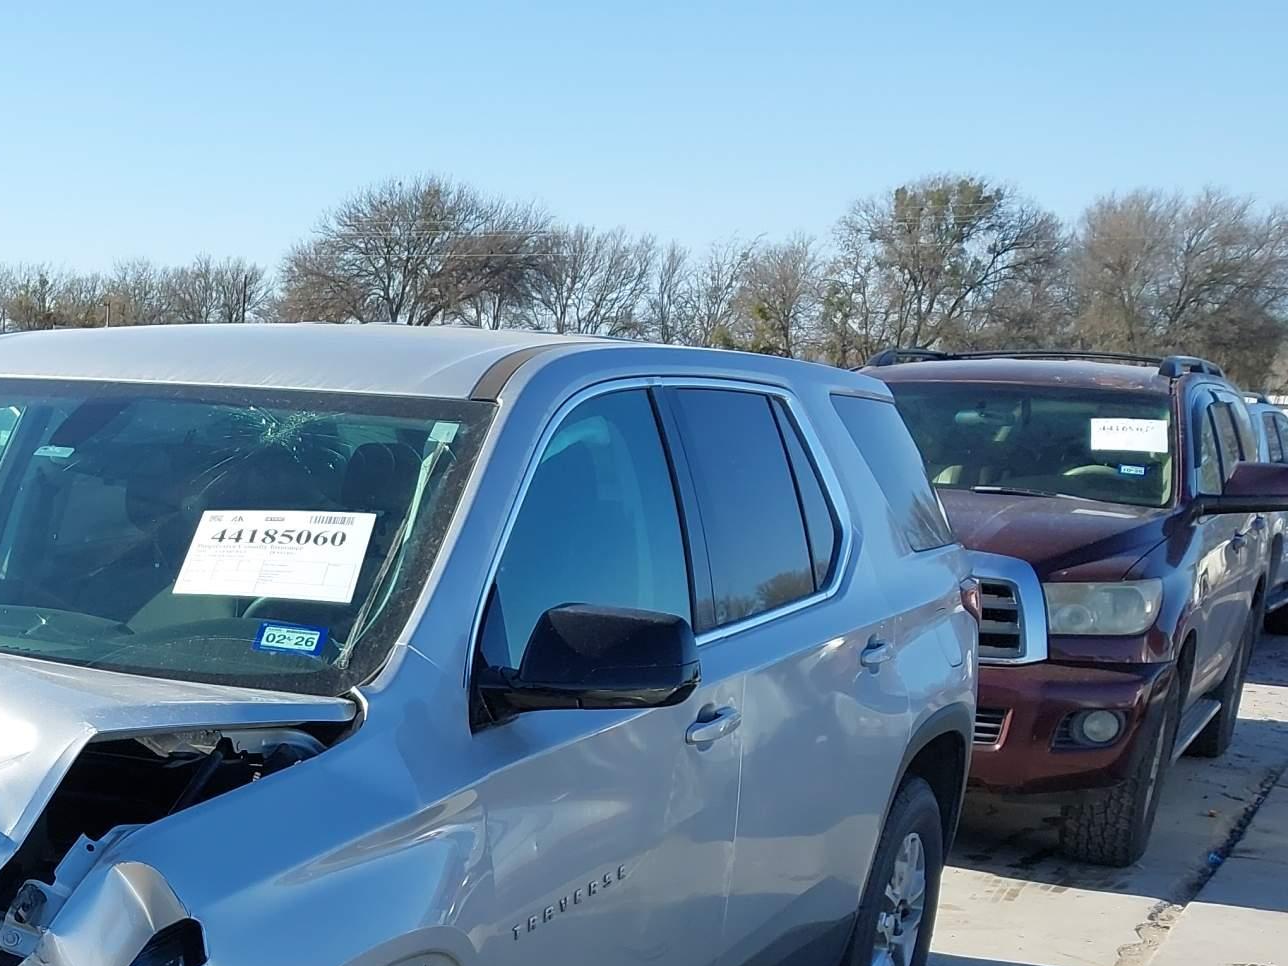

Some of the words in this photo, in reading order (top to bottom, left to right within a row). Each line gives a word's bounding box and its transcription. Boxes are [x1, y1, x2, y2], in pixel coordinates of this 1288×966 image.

[210, 527, 347, 548] 44185060
[265, 632, 287, 645] 02
[293, 635, 316, 648] 26
[511, 863, 627, 941] TRAVERSE
